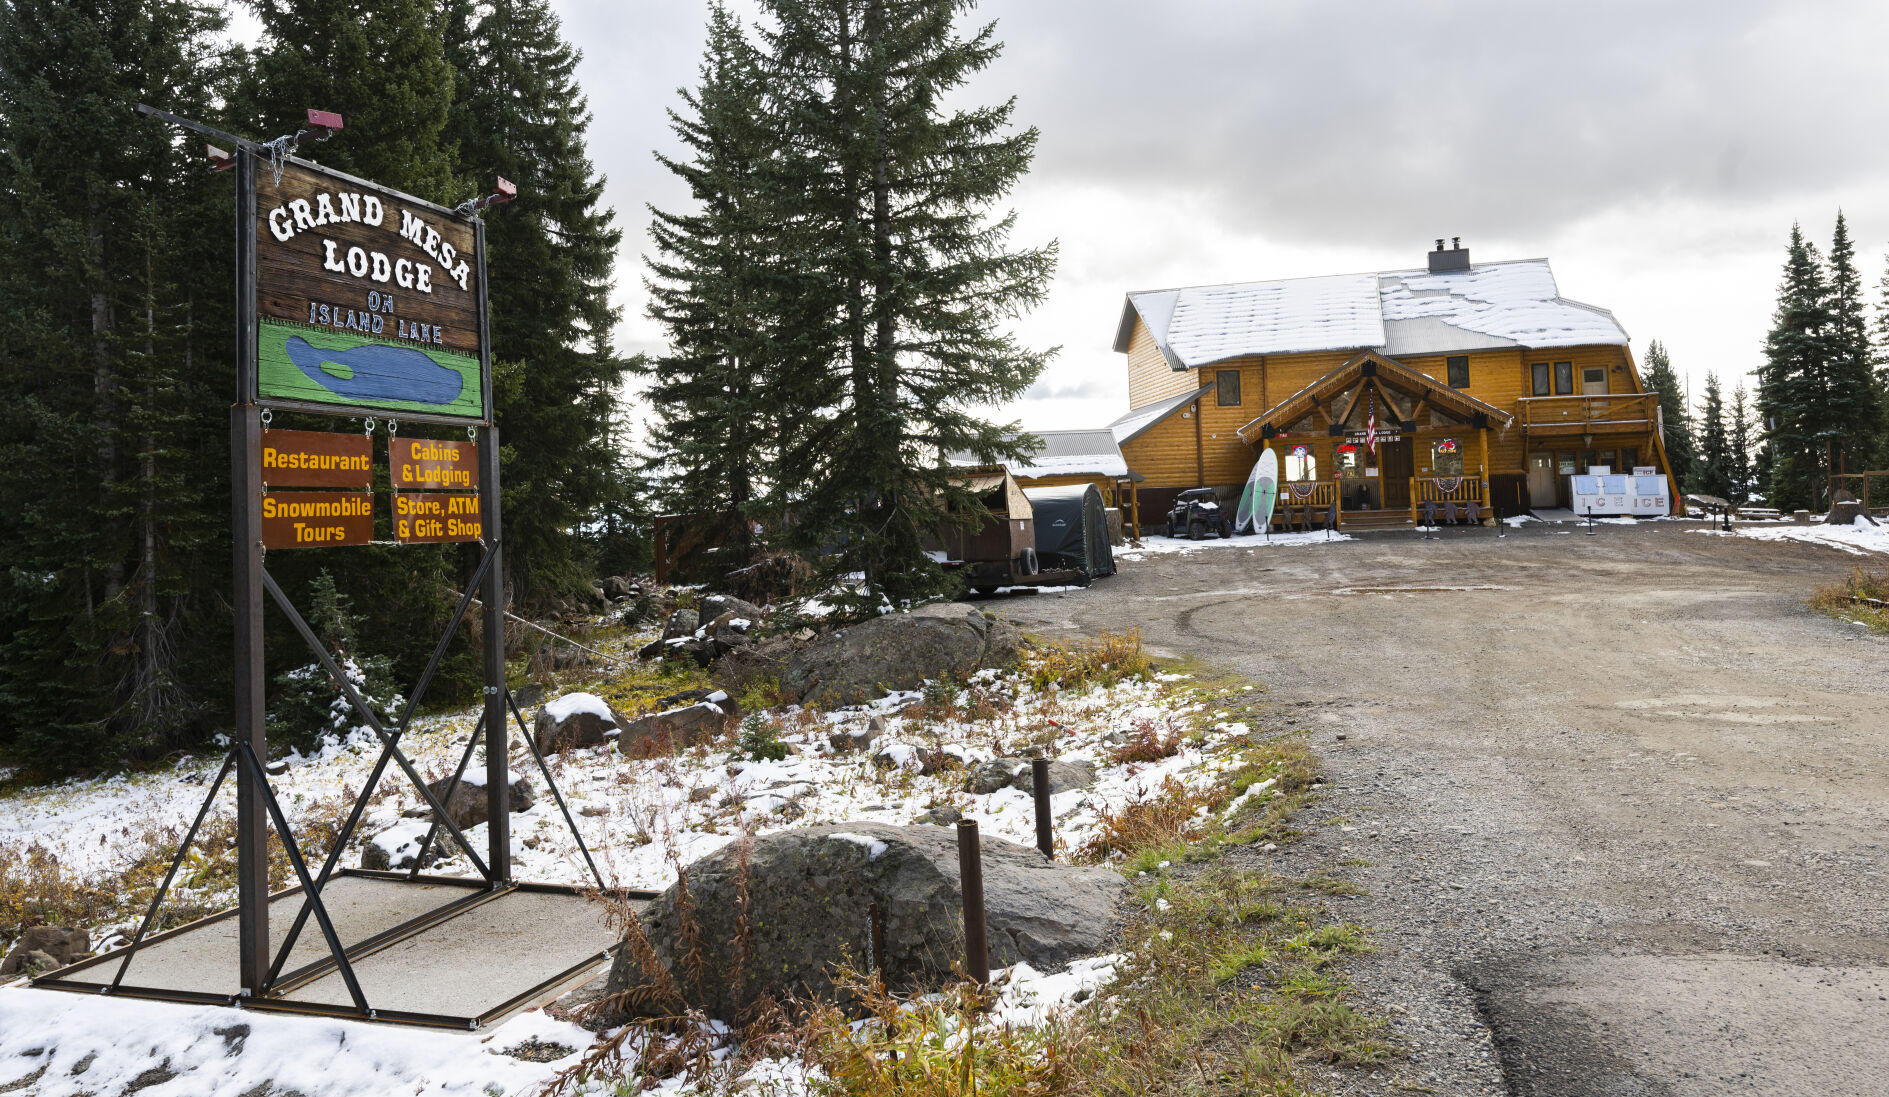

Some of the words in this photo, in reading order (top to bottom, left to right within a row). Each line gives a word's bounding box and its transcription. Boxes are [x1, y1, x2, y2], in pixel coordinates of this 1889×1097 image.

[268, 192, 384, 242] GRAND
[399, 209, 470, 291] MESA
[322, 239, 432, 293] LODGE
[368, 291, 393, 313] ON
[309, 302, 384, 334] ISLAND
[399, 319, 443, 344] LAKE
[263, 447, 370, 471] Restaurant
[411, 442, 460, 462] Cabins
[1337, 444, 1357, 453] OPEN
[402, 464, 413, 482] &
[416, 465, 470, 487] Lodging
[263, 497, 371, 518] Snowmobile
[397, 497, 445, 517] Store,
[448, 497, 479, 514] ATM
[1634, 497, 1664, 507] ICE
[293, 523, 345, 543] Tours
[398, 520, 410, 538] &
[415, 519, 443, 538] Gift
[447, 519, 481, 539] Shop
